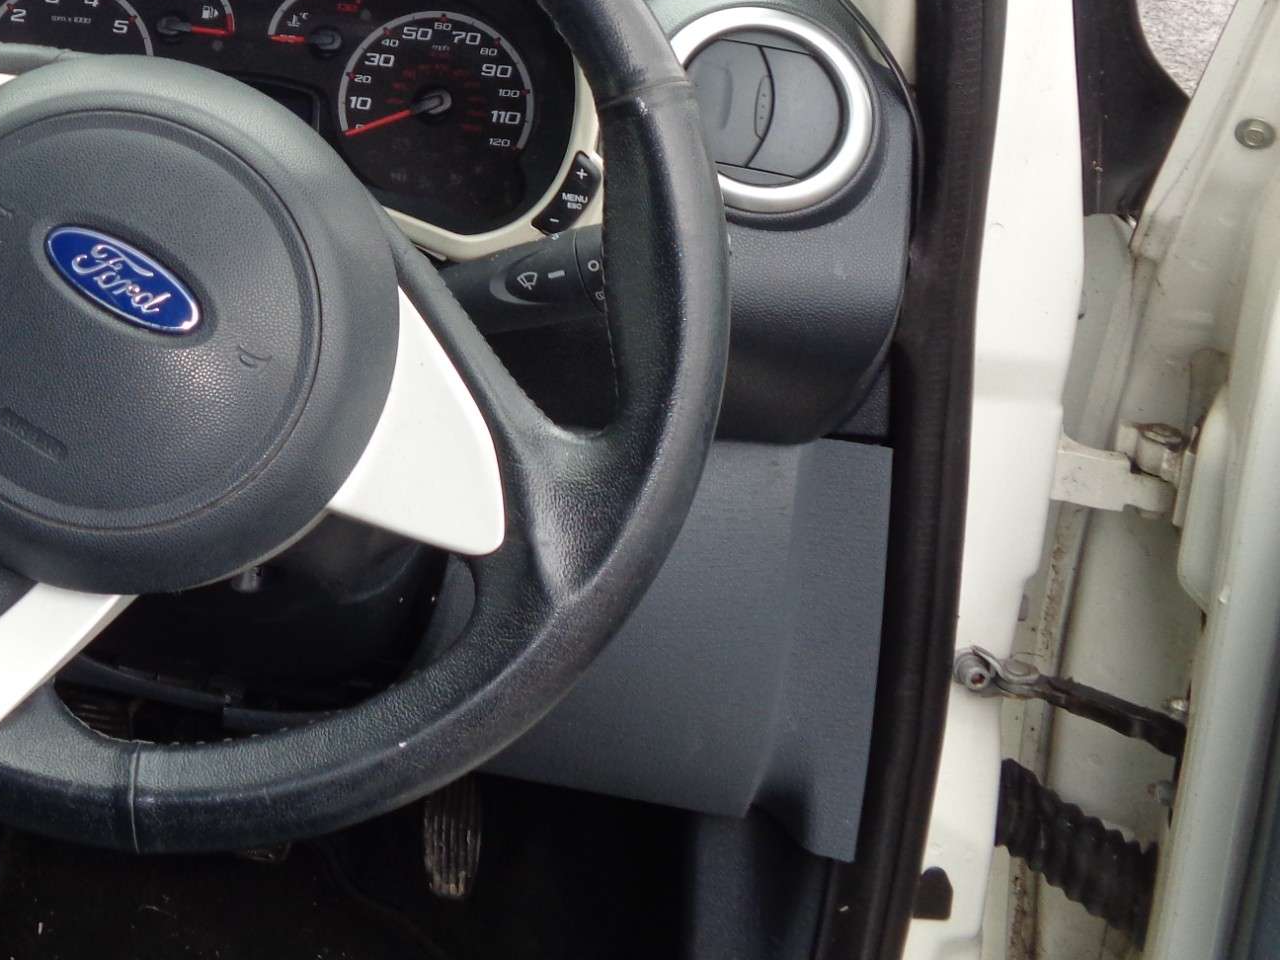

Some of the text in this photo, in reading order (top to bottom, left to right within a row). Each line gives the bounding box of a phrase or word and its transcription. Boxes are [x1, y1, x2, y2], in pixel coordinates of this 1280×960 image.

[10, 8, 27, 22] 2
[112, 20, 129, 34] 5
[402, 26, 433, 41] 50
[434, 22, 452, 31] 60
[381, 39, 399, 48] 40
[452, 30, 481, 46] 70
[479, 47, 498, 57] 80
[364, 52, 395, 67] 30
[480, 63, 512, 78] 90
[354, 74, 372, 84] 20
[498, 88, 520, 98] 100
[349, 96, 372, 110] 10
[490, 110, 521, 125] 110
[488, 137, 511, 147] 120
[562, 192, 588, 204] MENU
[71, 243, 171, 313] Ford
